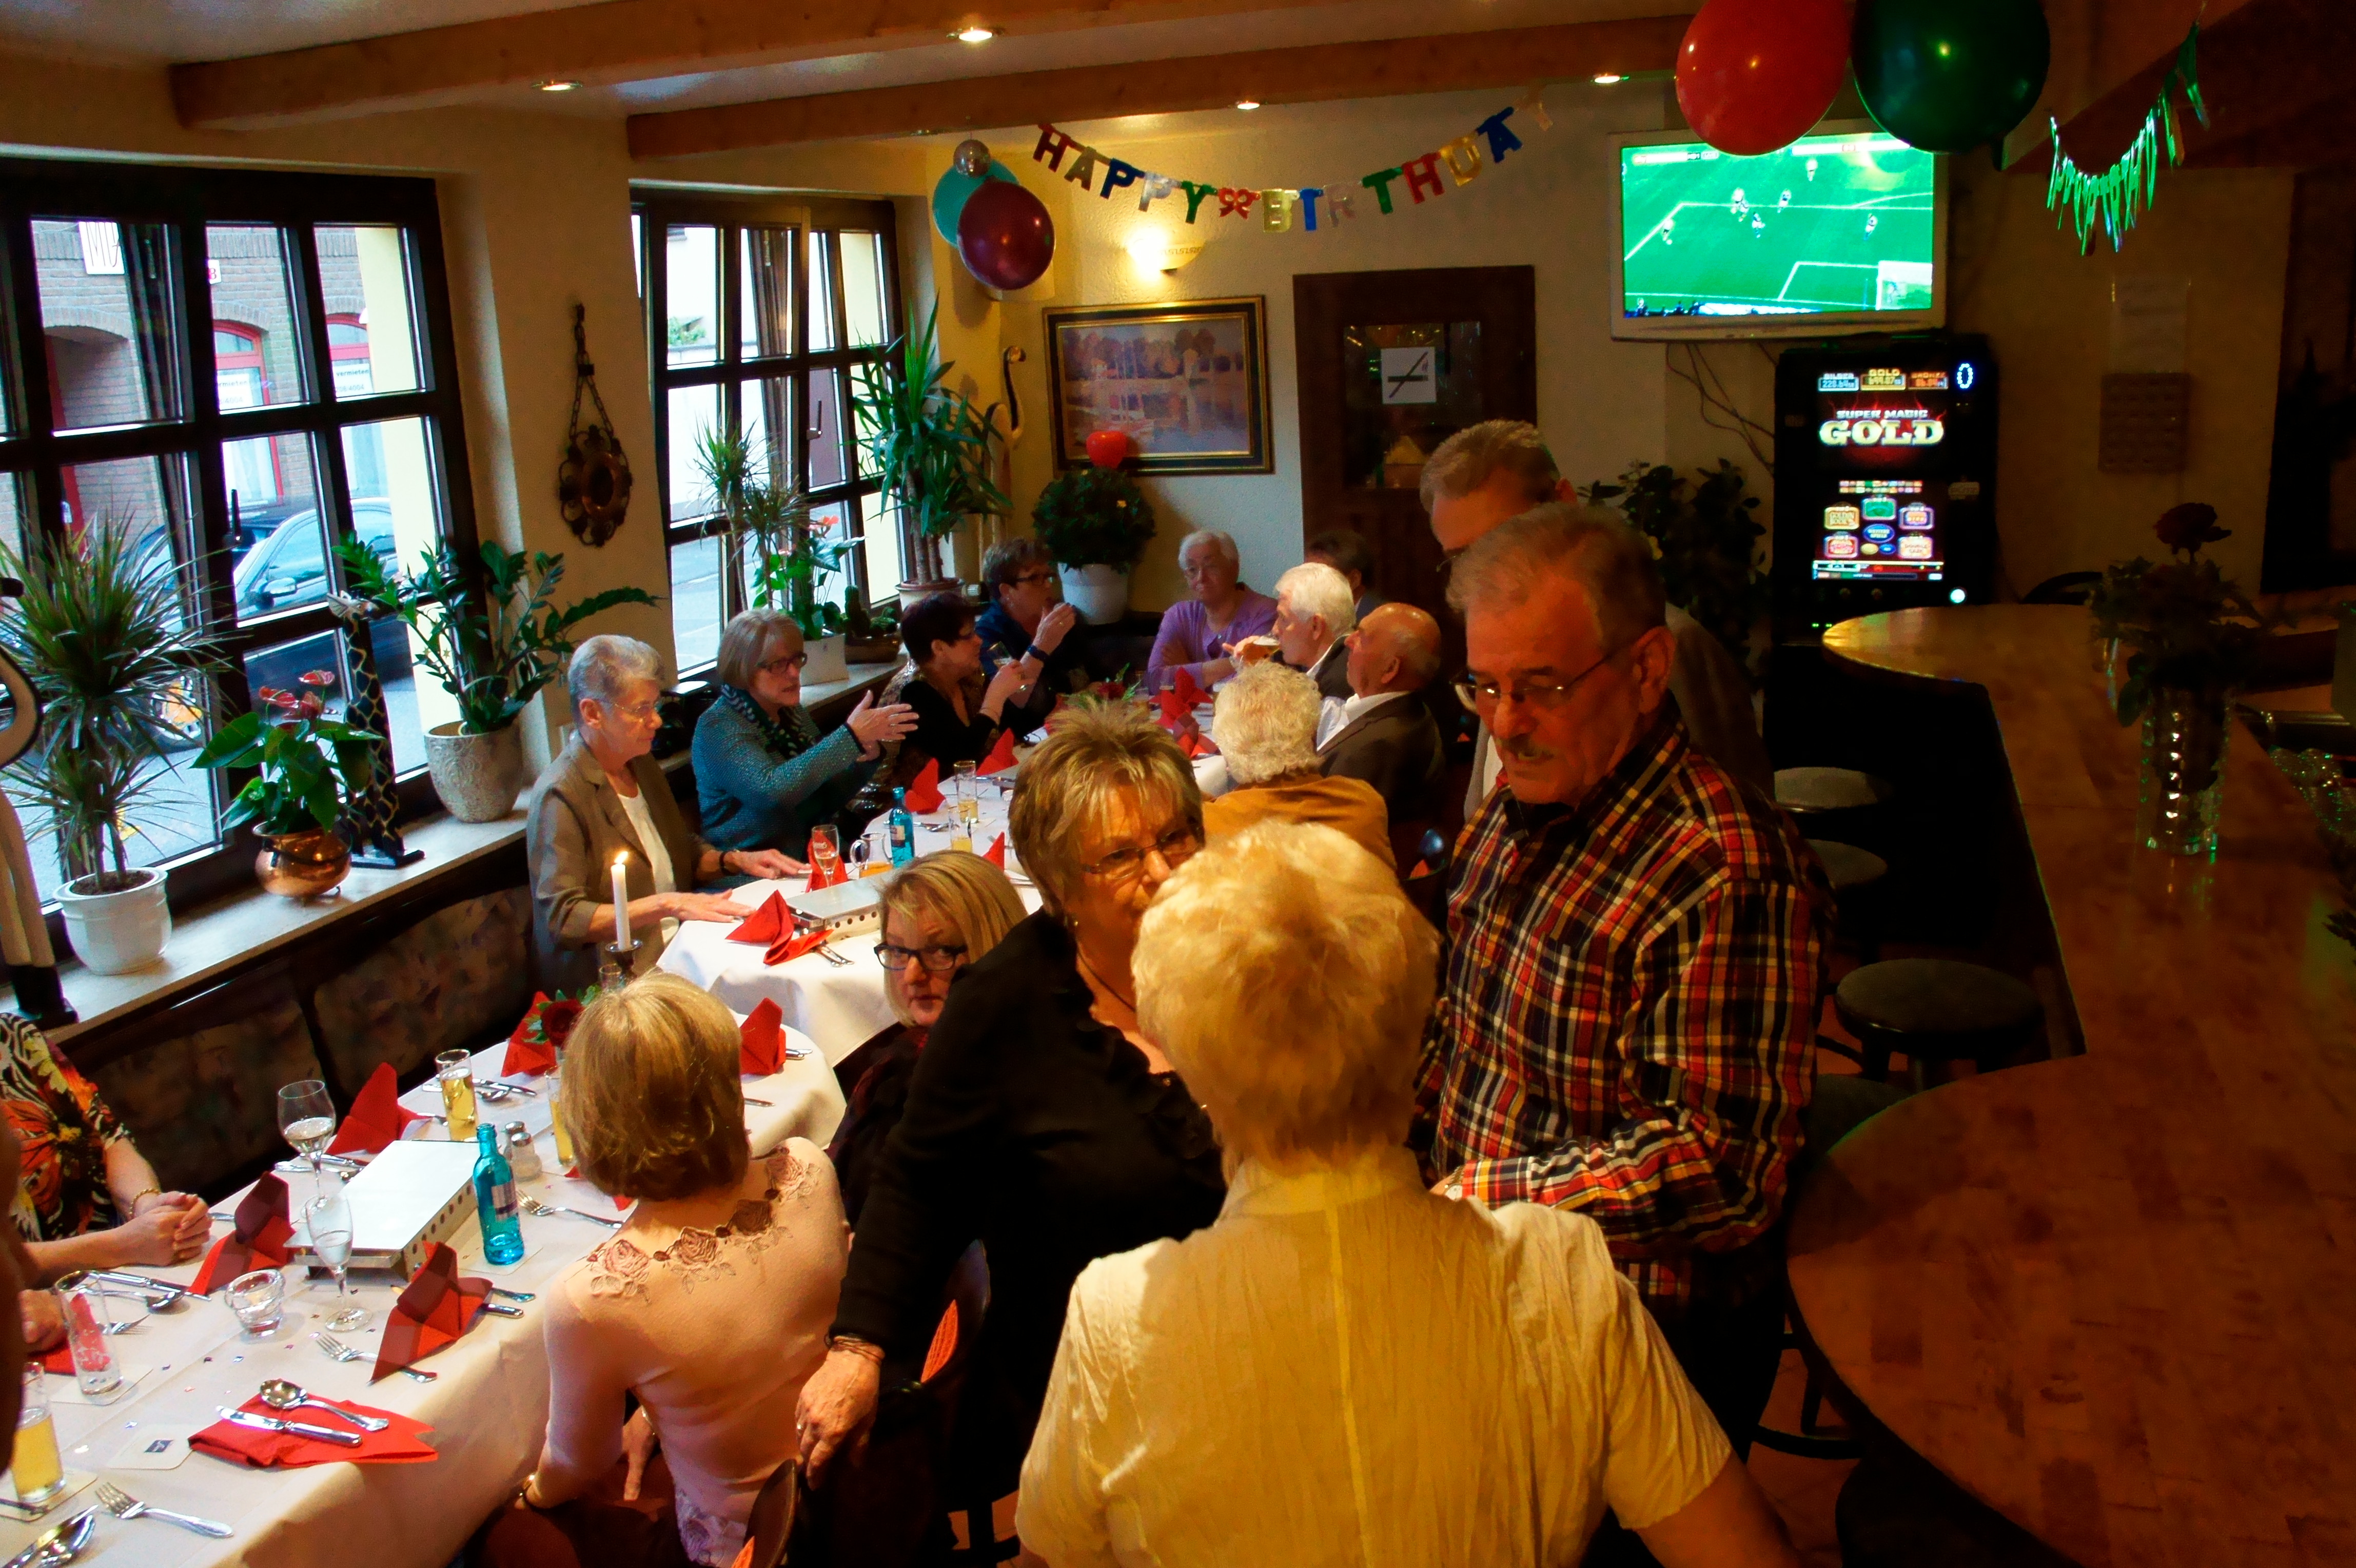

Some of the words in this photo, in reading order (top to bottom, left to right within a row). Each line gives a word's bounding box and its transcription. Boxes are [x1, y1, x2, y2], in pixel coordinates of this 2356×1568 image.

[1032, 124, 1216, 224] HAPPY
[1956, 363, 1974, 389] 0
[1836, 410, 1881, 419] SUPER
[1884, 409, 1928, 419] MAGIC
[1819, 420, 1945, 446] GOLD
